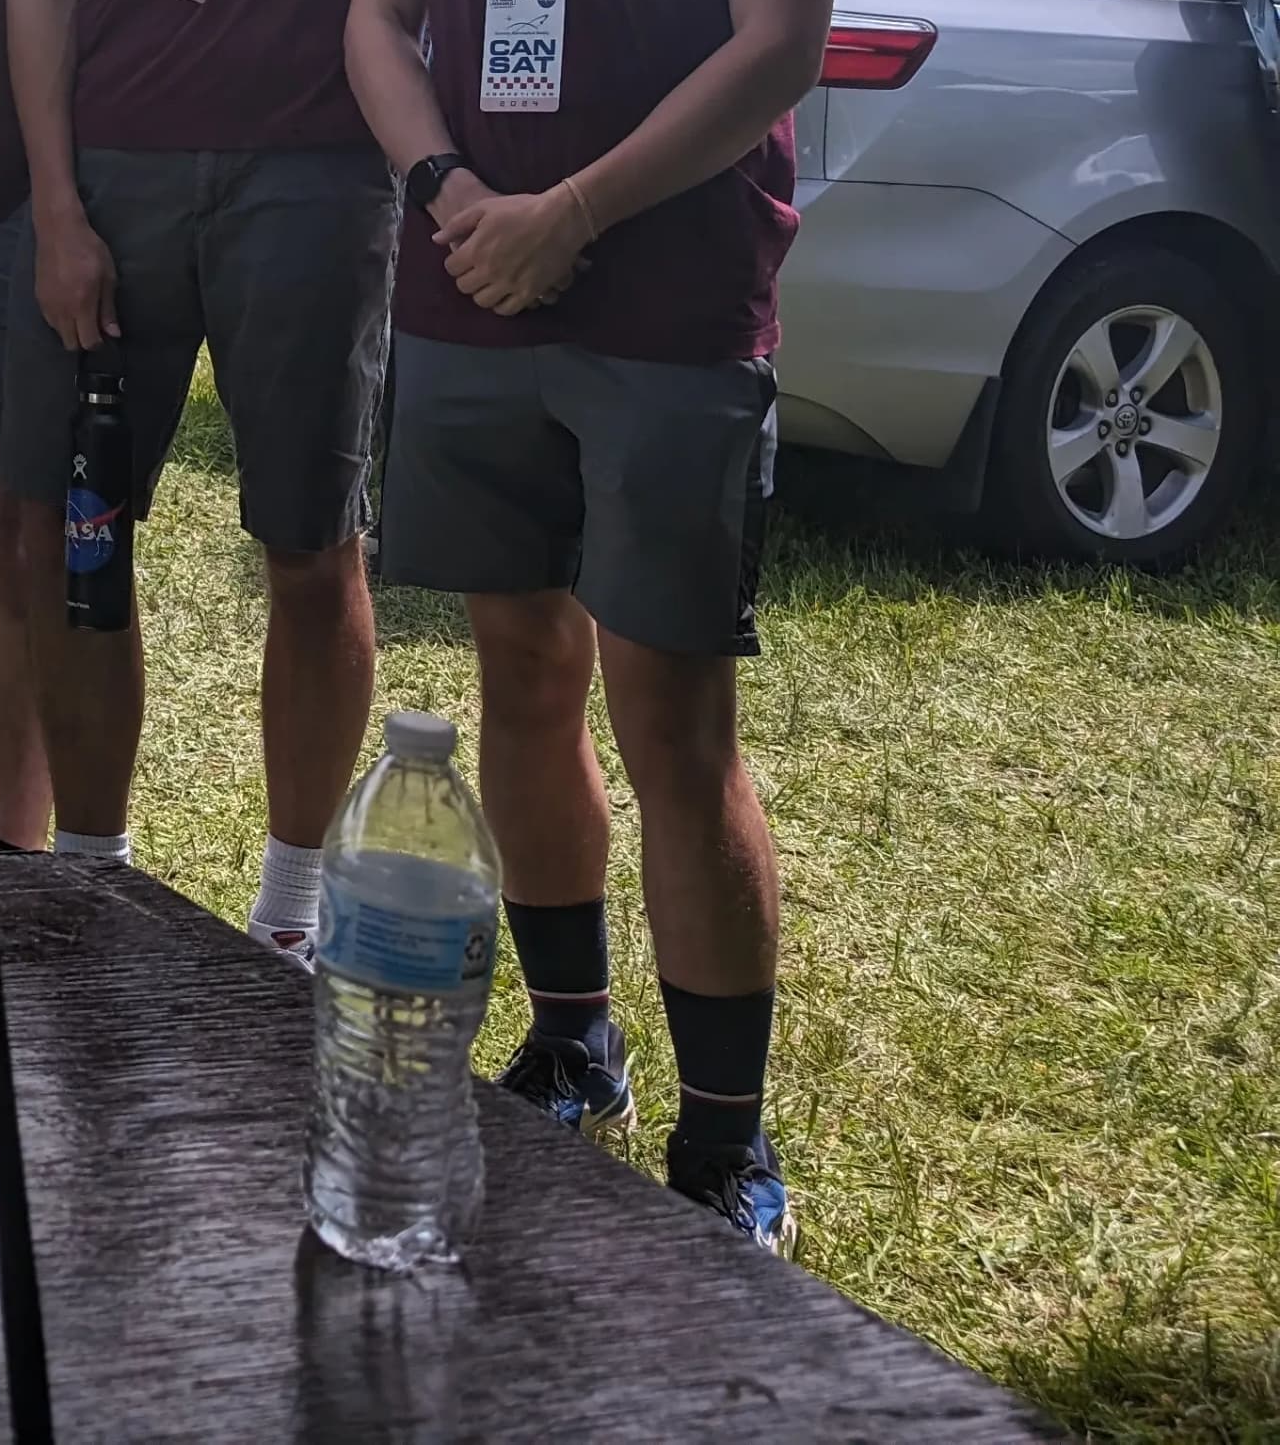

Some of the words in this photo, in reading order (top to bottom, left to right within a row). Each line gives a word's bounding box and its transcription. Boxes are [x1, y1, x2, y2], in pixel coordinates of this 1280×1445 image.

[490, 39, 556, 55] CAN
[489, 56, 555, 74] SAT
[65, 520, 114, 542] ASA
